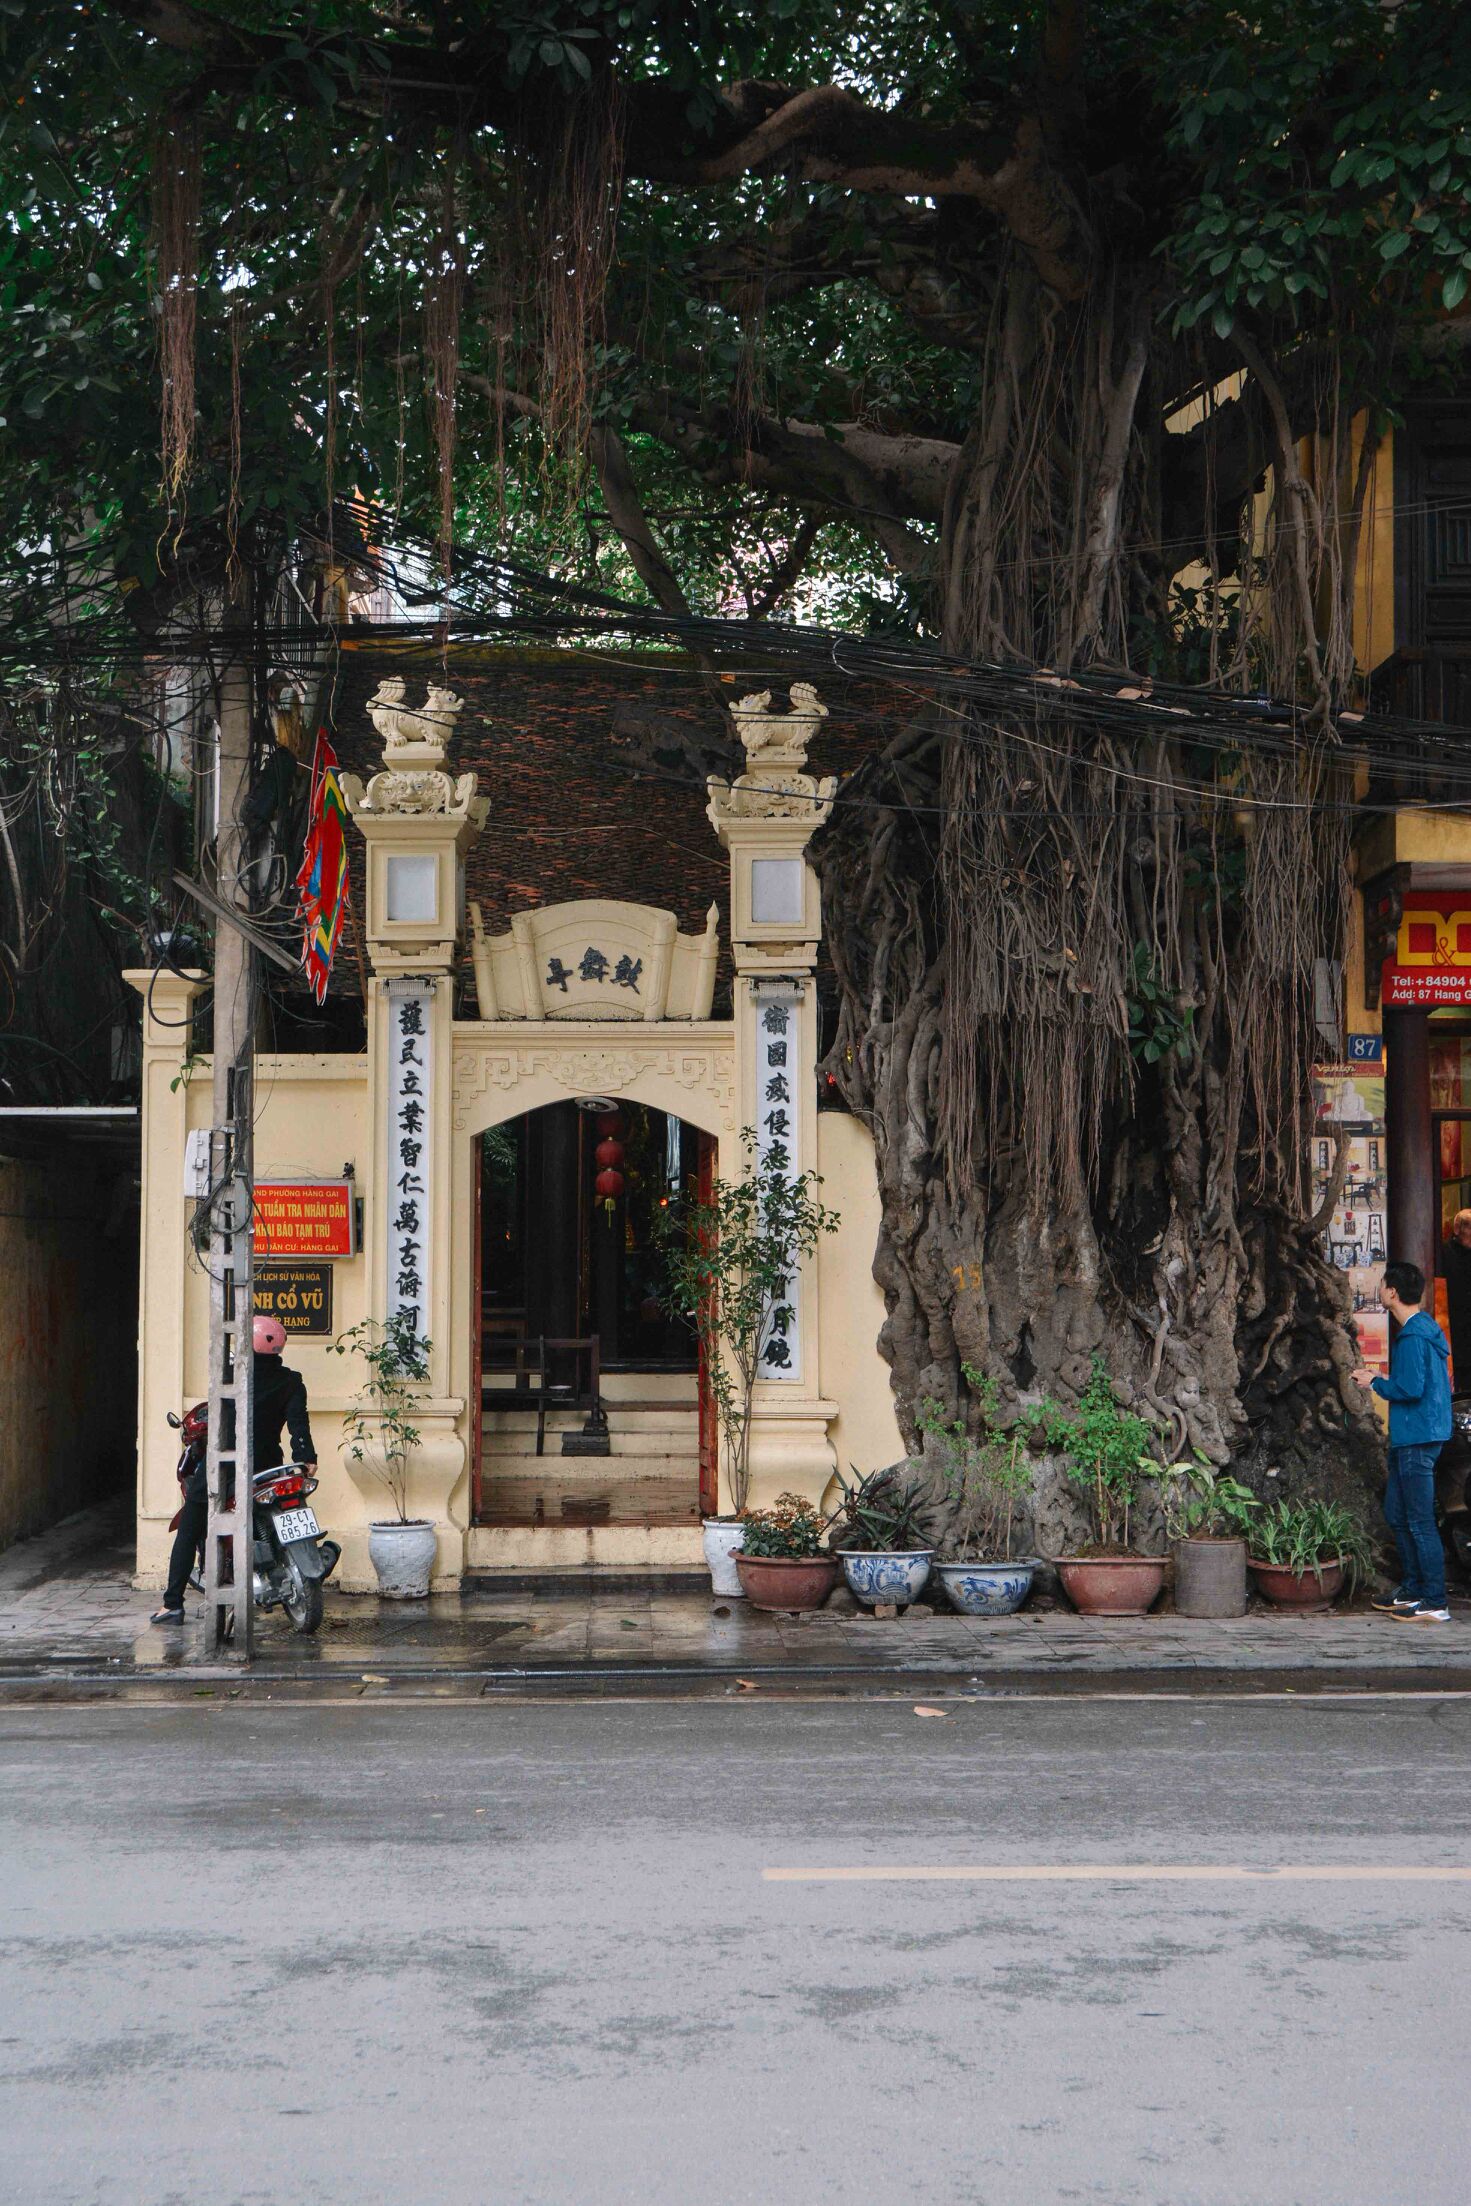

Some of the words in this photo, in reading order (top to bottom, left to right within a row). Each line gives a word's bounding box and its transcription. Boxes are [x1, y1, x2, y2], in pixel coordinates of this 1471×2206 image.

[1392, 990, 1416, 999] Add:
[1418, 990, 1431, 999] 87
[1434, 990, 1461, 1001] Hang
[1354, 1038, 1376, 1056] 87
[302, 1188, 324, 1197] HÀNG
[287, 1204, 302, 1217] TRA
[304, 1201, 327, 1218] NHÂN
[329, 1202, 347, 1218] DÂN
[277, 1221, 293, 1237] BÁO
[296, 1223, 313, 1240] TẠM
[315, 1222, 331, 1238] TRÚ
[263, 1272, 278, 1283] LỊCH
[290, 1271, 305, 1281] VĂN
[277, 1284, 297, 1310] CỔ
[301, 1288, 323, 1310] VŨ
[284, 1316, 310, 1328] HẠNG
[280, 1510, 309, 1527] 29-C1
[281, 1522, 317, 1540] 685.26
